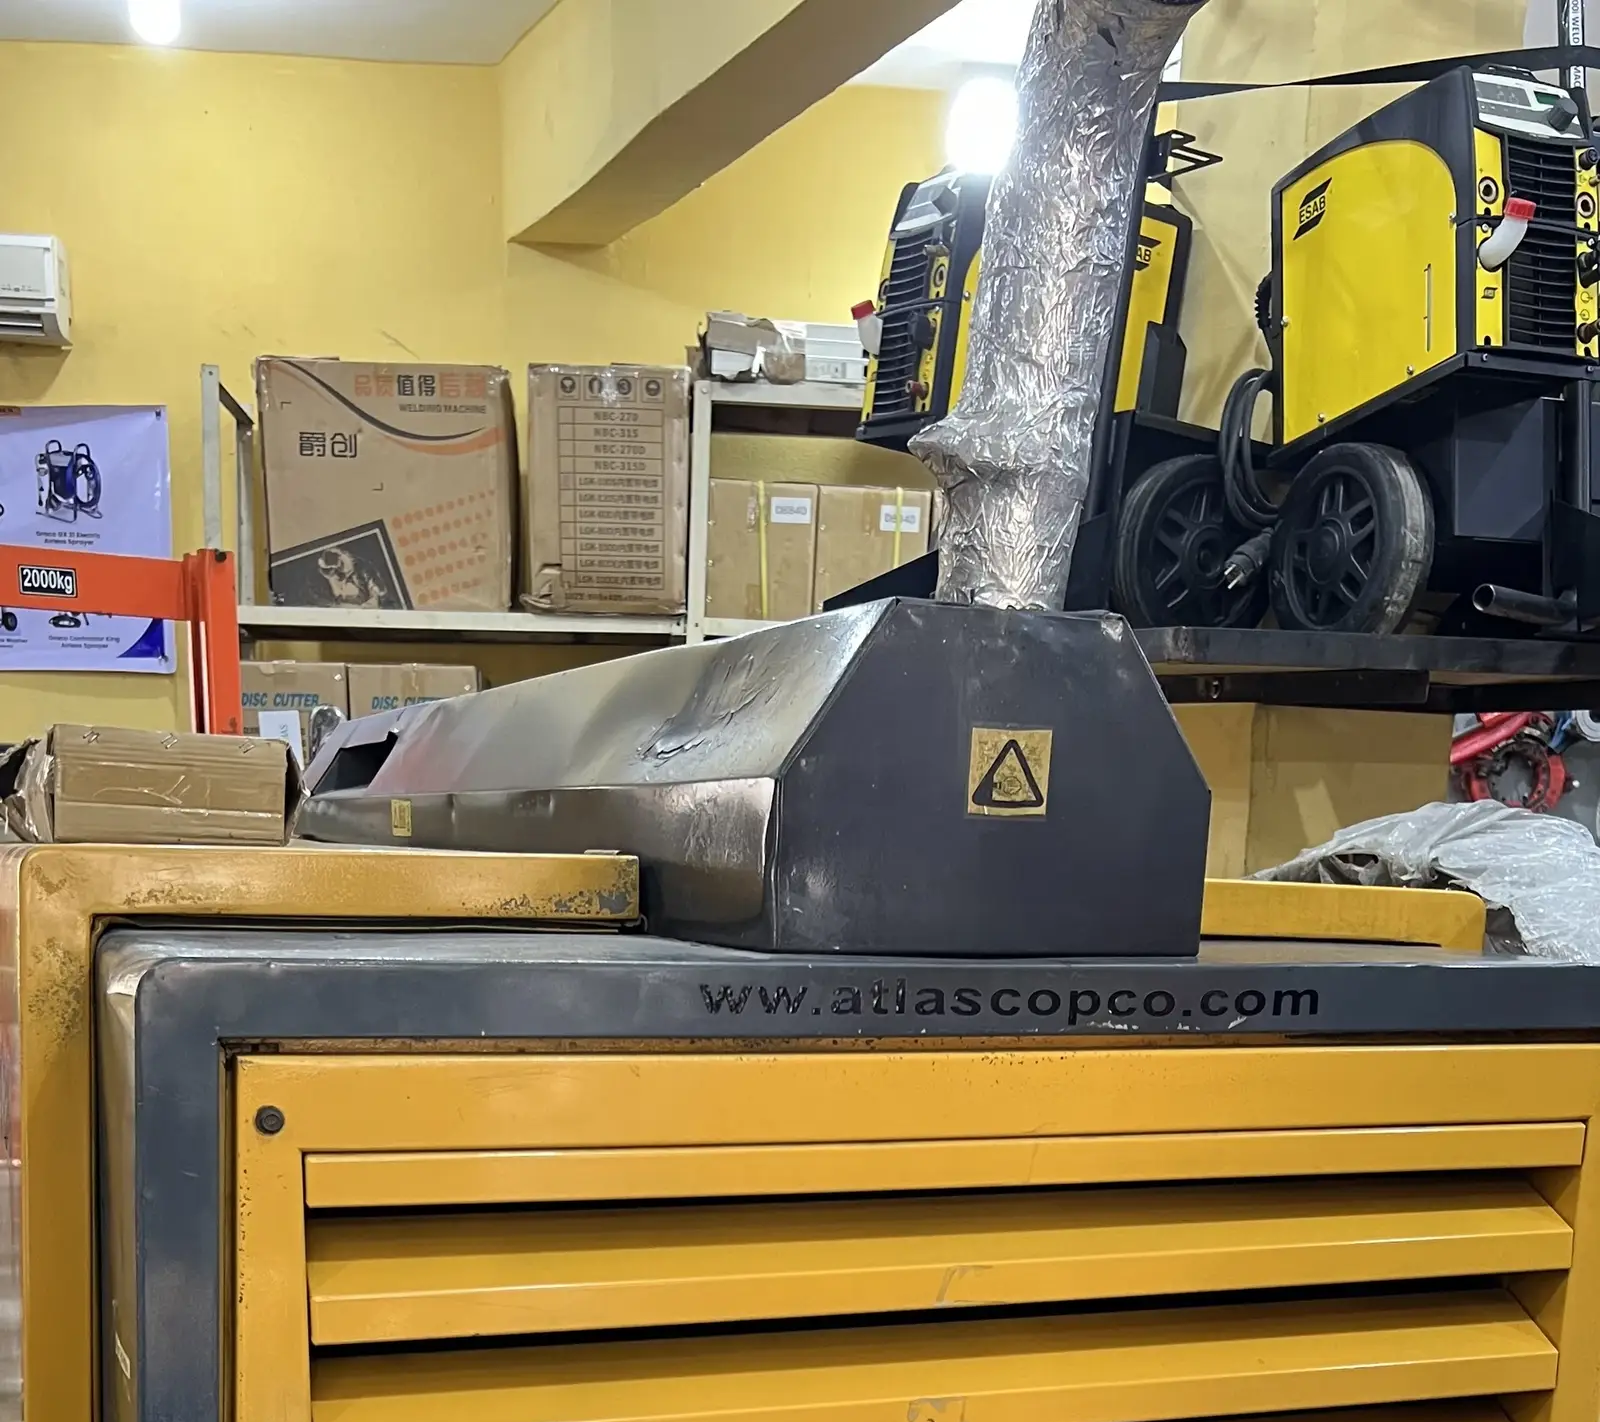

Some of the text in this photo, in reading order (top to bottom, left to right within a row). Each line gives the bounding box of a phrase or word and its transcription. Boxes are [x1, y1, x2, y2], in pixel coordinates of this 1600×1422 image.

[1571, 16, 1581, 44] WELD
[1299, 194, 1326, 224] ESAB
[443, 404, 487, 415] MACHINE
[22, 568, 74, 595] 2000kg
[241, 692, 320, 707] DISC CUTTER
[371, 695, 399, 710] DISC
[699, 976, 1320, 1025] www.atlascopco.com
